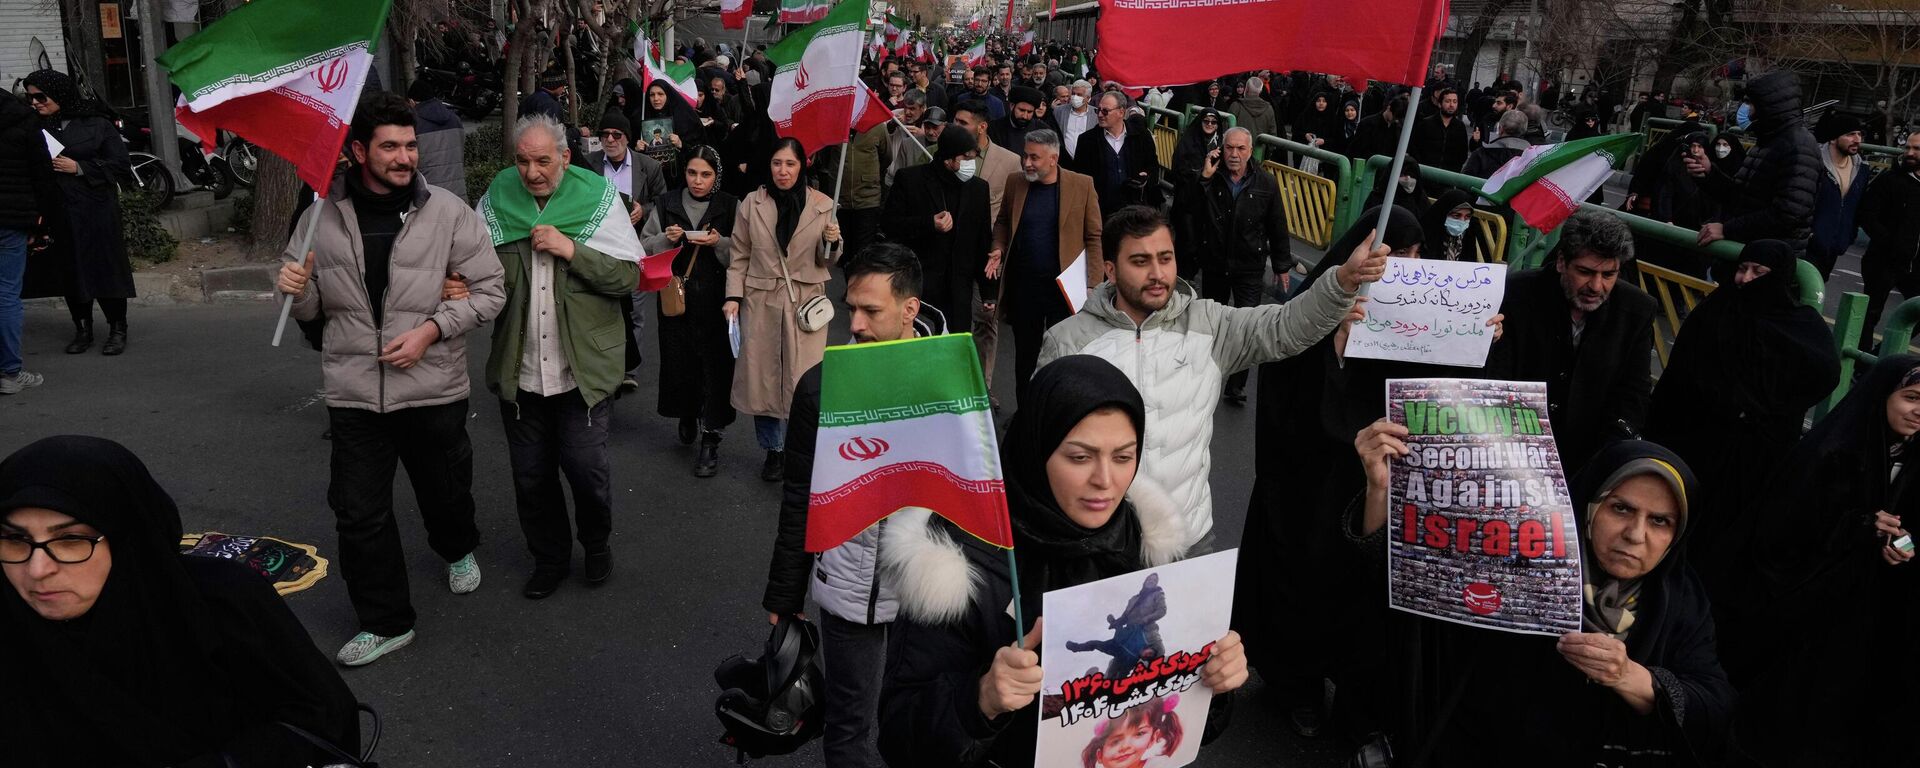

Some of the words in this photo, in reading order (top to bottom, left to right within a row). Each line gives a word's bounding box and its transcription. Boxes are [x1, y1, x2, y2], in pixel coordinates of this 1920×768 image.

[1403, 400, 1515, 437] Victory
[1513, 402, 1544, 436] in
[1406, 442, 1503, 470] Second
[1504, 442, 1549, 470] War
[1405, 470, 1559, 508] Against
[1402, 504, 1566, 558] Israel
